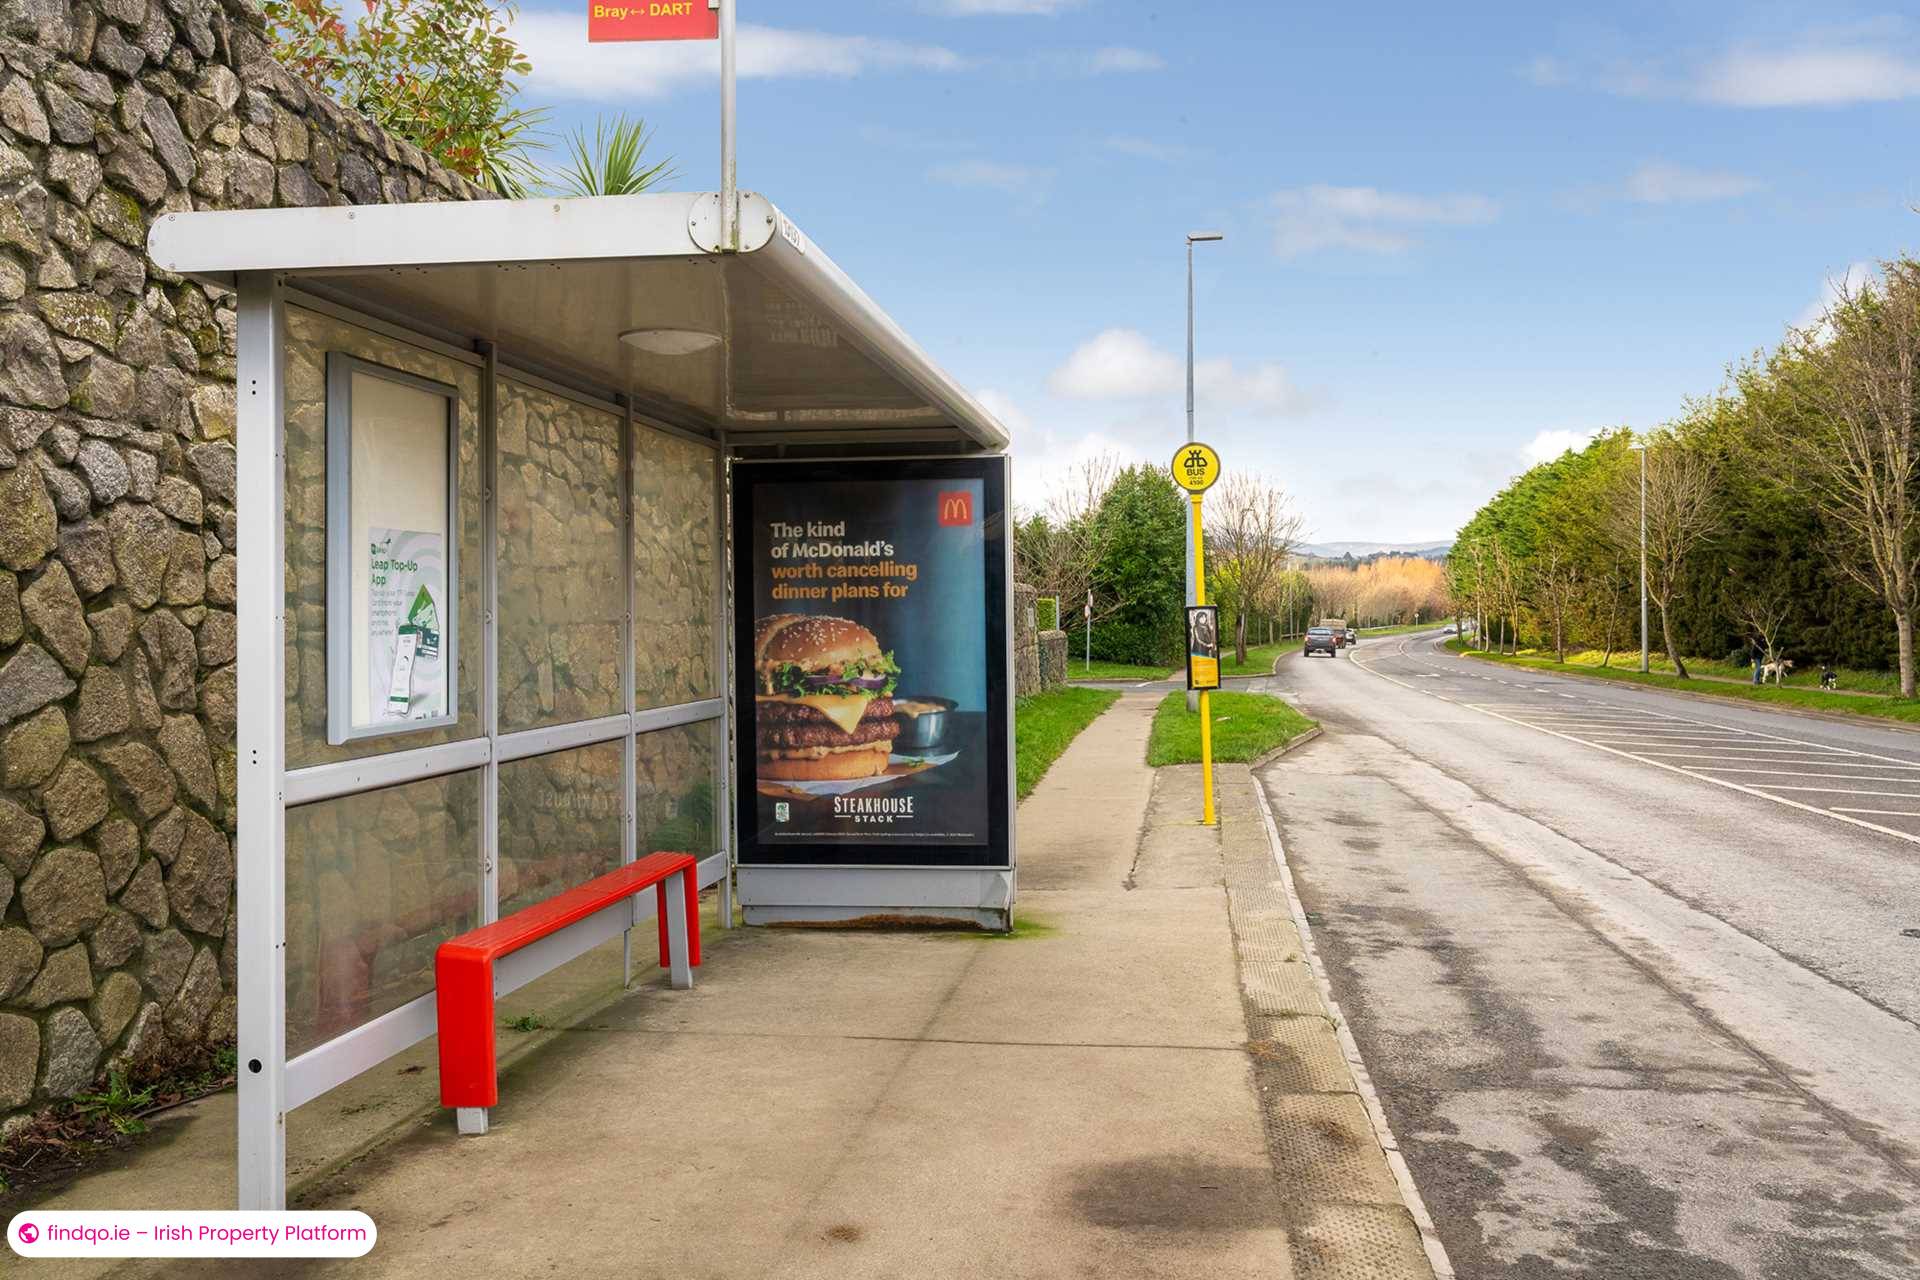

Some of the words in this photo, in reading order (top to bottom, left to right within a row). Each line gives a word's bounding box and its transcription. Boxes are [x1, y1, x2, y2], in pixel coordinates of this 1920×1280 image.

[594, 5, 628, 20] Bray
[650, 3, 693, 16] DART
[1186, 468, 1205, 476] BUS
[771, 522, 804, 538] The
[807, 521, 845, 537] kind
[771, 543, 790, 558] of
[792, 541, 894, 558] McDonald's
[371, 559, 389, 572] Leap
[391, 560, 418, 573] Top-Up
[772, 563, 823, 579] worth
[827, 561, 917, 580] cancelling
[772, 583, 828, 599] dinner
[832, 583, 880, 602] plans
[883, 582, 909, 597] for
[834, 796, 914, 813] STEAKHOUSE
[855, 815, 894, 823] STACK
